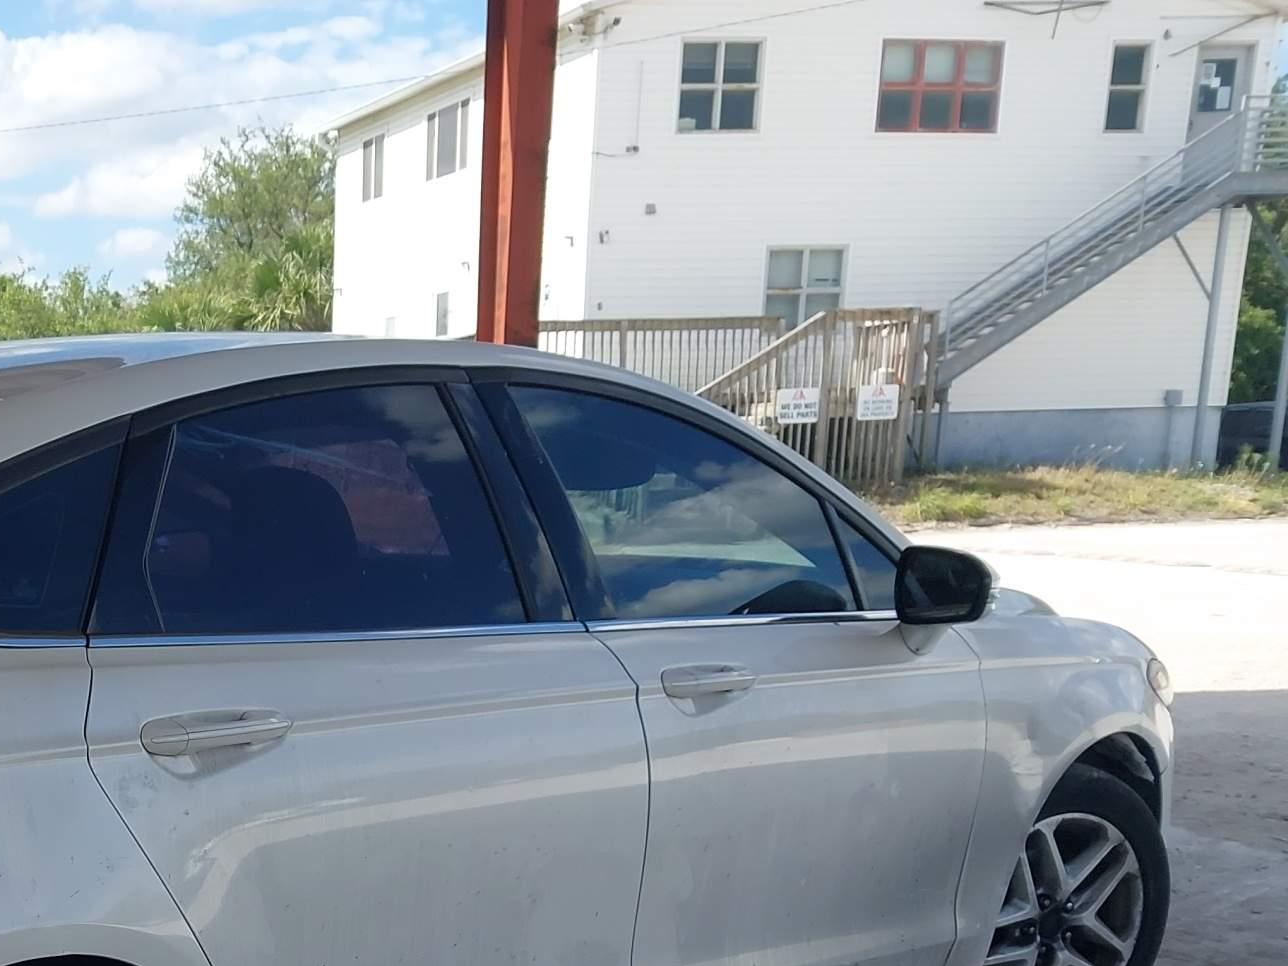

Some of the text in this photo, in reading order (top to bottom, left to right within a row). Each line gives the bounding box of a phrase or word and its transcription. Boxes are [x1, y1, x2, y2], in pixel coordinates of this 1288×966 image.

[793, 402, 803, 410] DO
[779, 410, 817, 419] SELL PARTS
